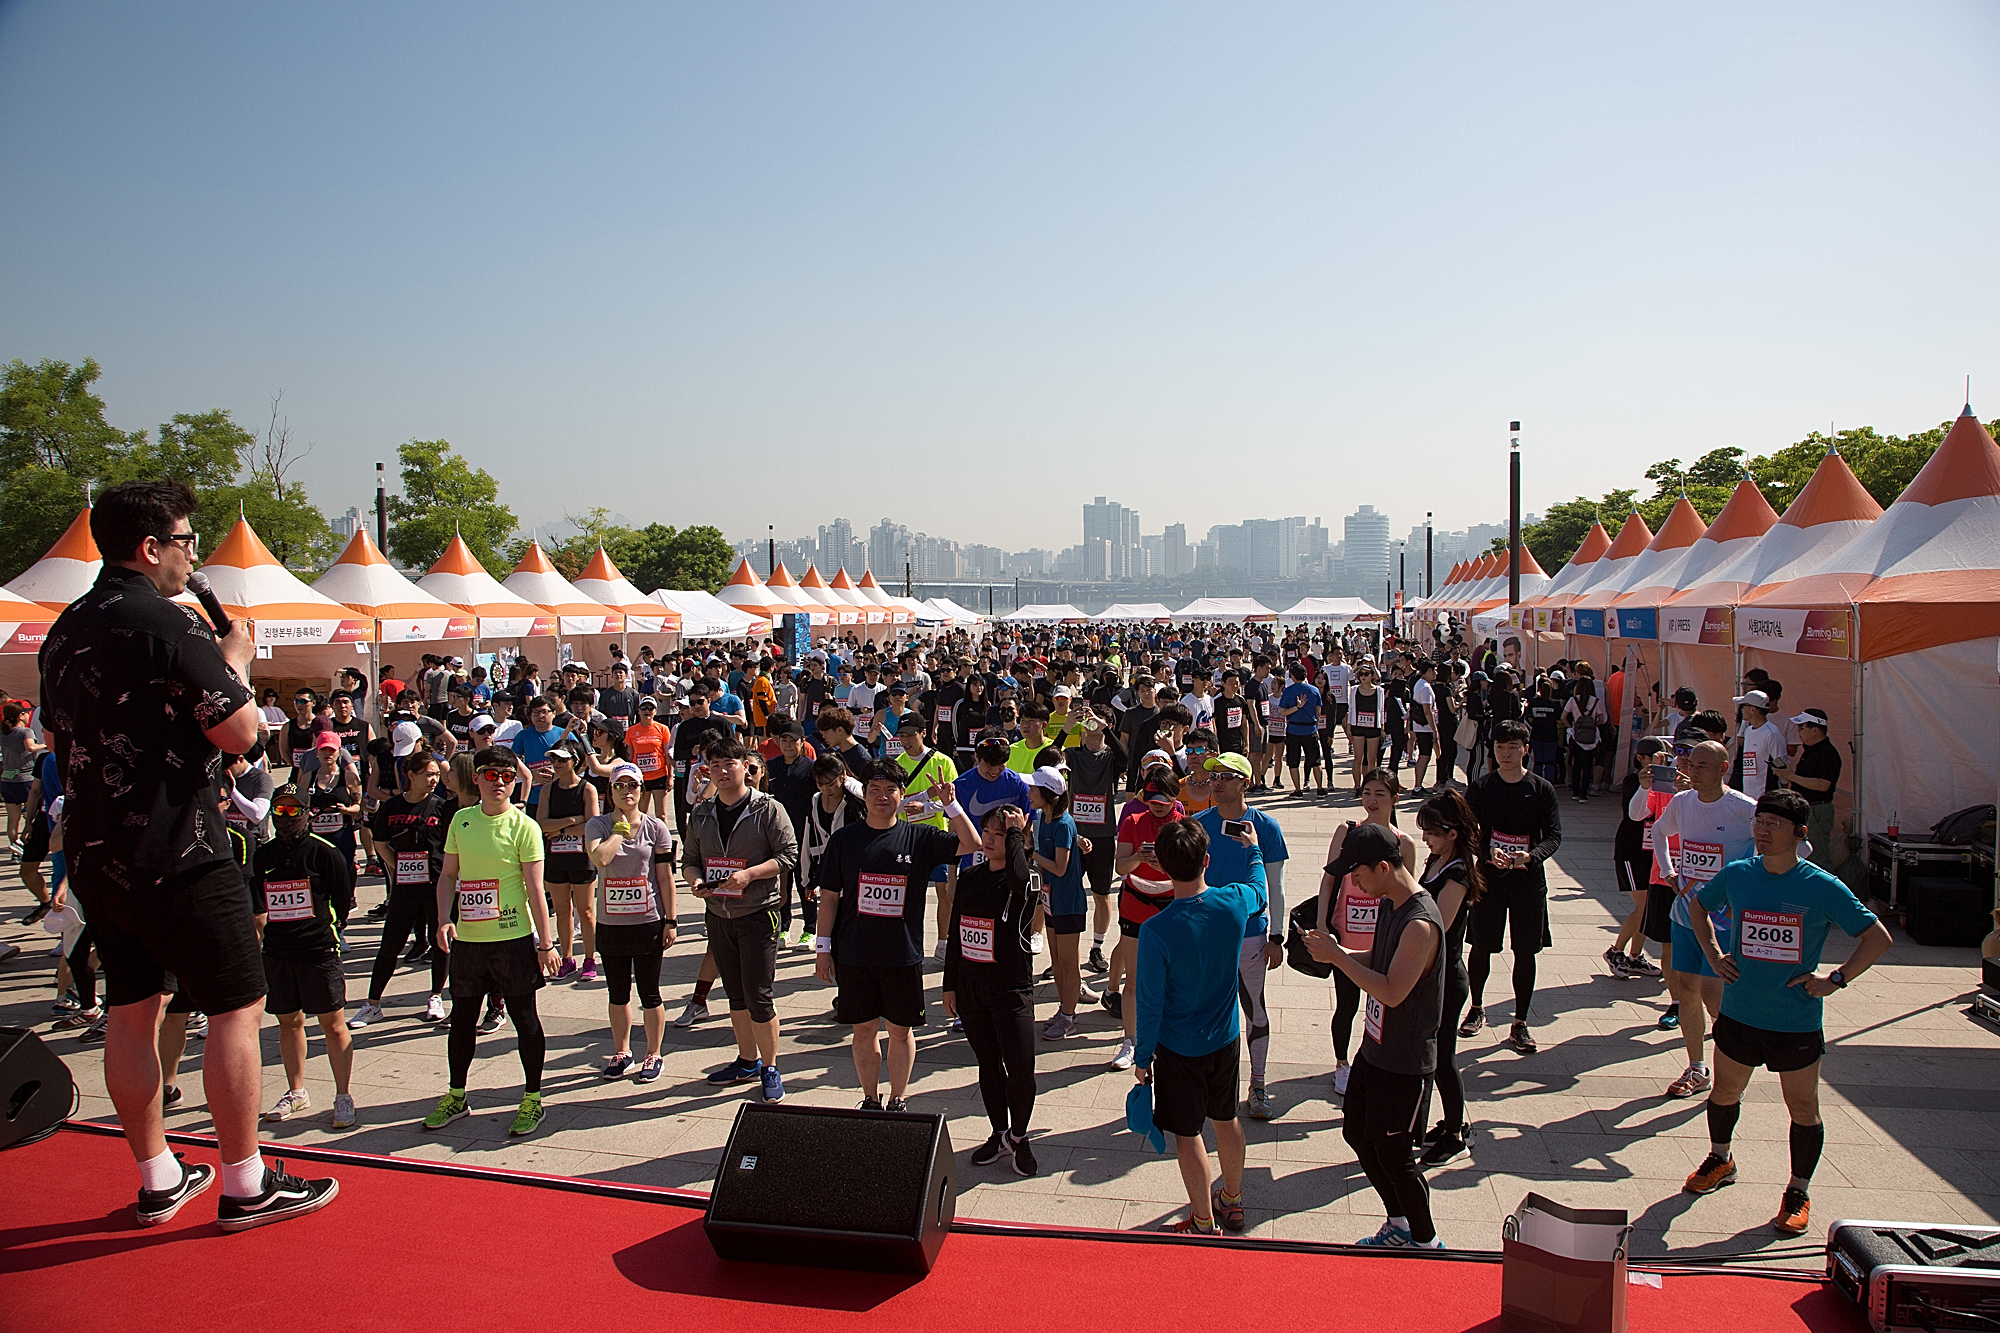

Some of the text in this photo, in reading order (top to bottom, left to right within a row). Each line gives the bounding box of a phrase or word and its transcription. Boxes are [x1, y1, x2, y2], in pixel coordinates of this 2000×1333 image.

[1677, 619, 1691, 631] PRESS
[1704, 621, 1730, 632] Burning Run
[1748, 619, 1784, 638] 사회자대기실
[264, 627, 322, 638] 진행본부/등록확인
[340, 627, 362, 635] Burning
[1806, 627, 1846, 640] Burning Run
[18, 633, 48, 642] Burnin
[887, 741, 903, 749] 310
[638, 758, 656, 766] 2870
[1076, 802, 1102, 813] 3026
[1493, 832, 1527, 843] Burning Run
[1683, 841, 1720, 852] Burning Run
[708, 857, 743, 867] Burning Run
[1685, 851, 1717, 867] 3097
[399, 861, 424, 871] 2666
[861, 874, 890, 883] Burning
[270, 892, 305, 906] 2415
[461, 892, 493, 906] 2806
[609, 889, 642, 901] 2750
[863, 886, 899, 901] 2001
[1348, 897, 1374, 905] Burning
[1351, 908, 1376, 920] 271
[1744, 911, 1798, 924] Burning Run
[978, 919, 992, 927] Run
[962, 928, 988, 945] 2605
[1747, 925, 1794, 943] 2608
